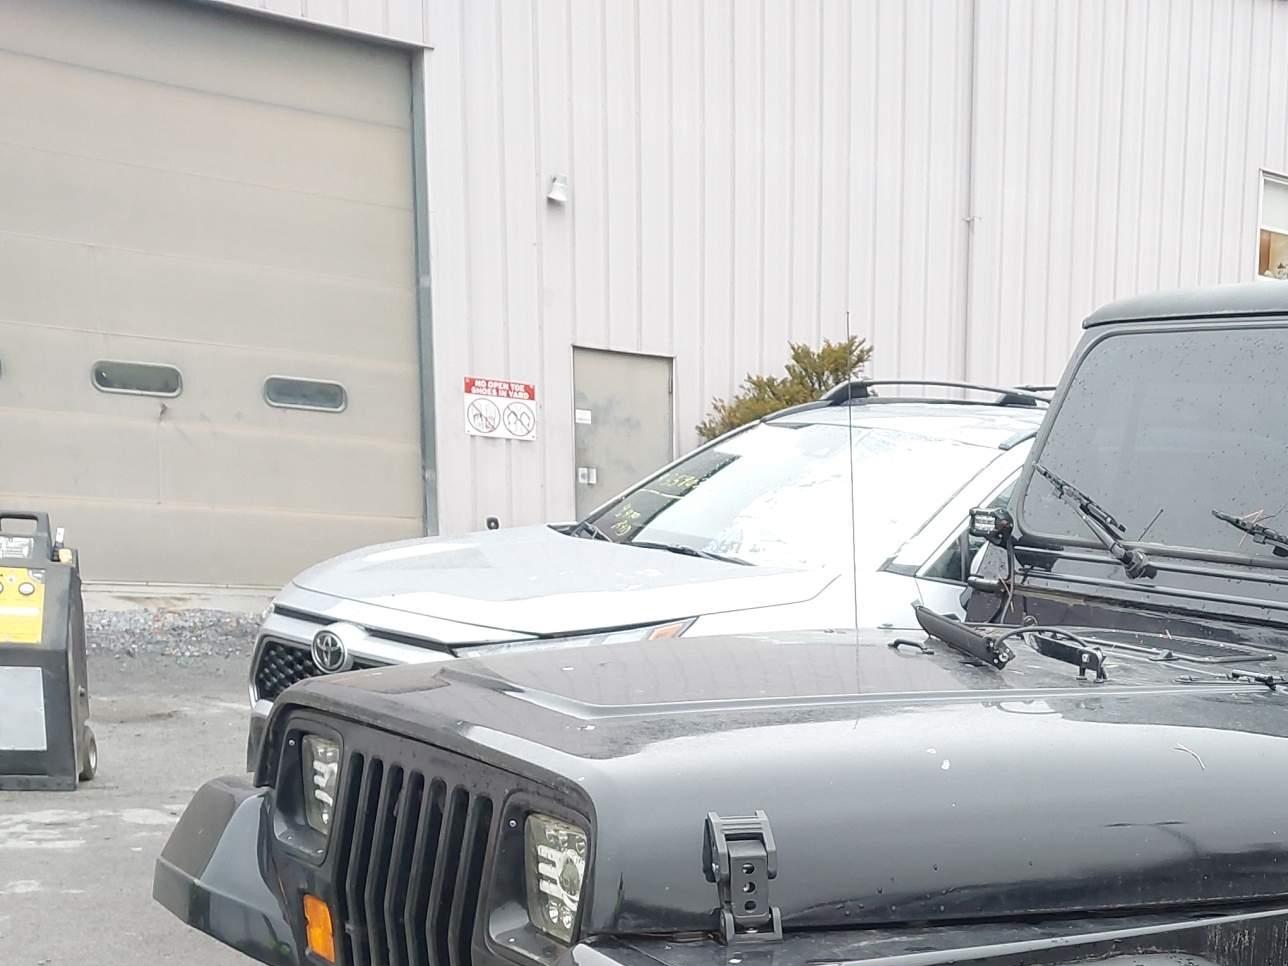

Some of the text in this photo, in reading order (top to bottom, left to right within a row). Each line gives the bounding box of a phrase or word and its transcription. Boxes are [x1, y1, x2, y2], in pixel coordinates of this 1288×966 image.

[474, 380, 525, 392] NO OPEN TOE
[471, 386, 530, 399] SHOES IN YARD
